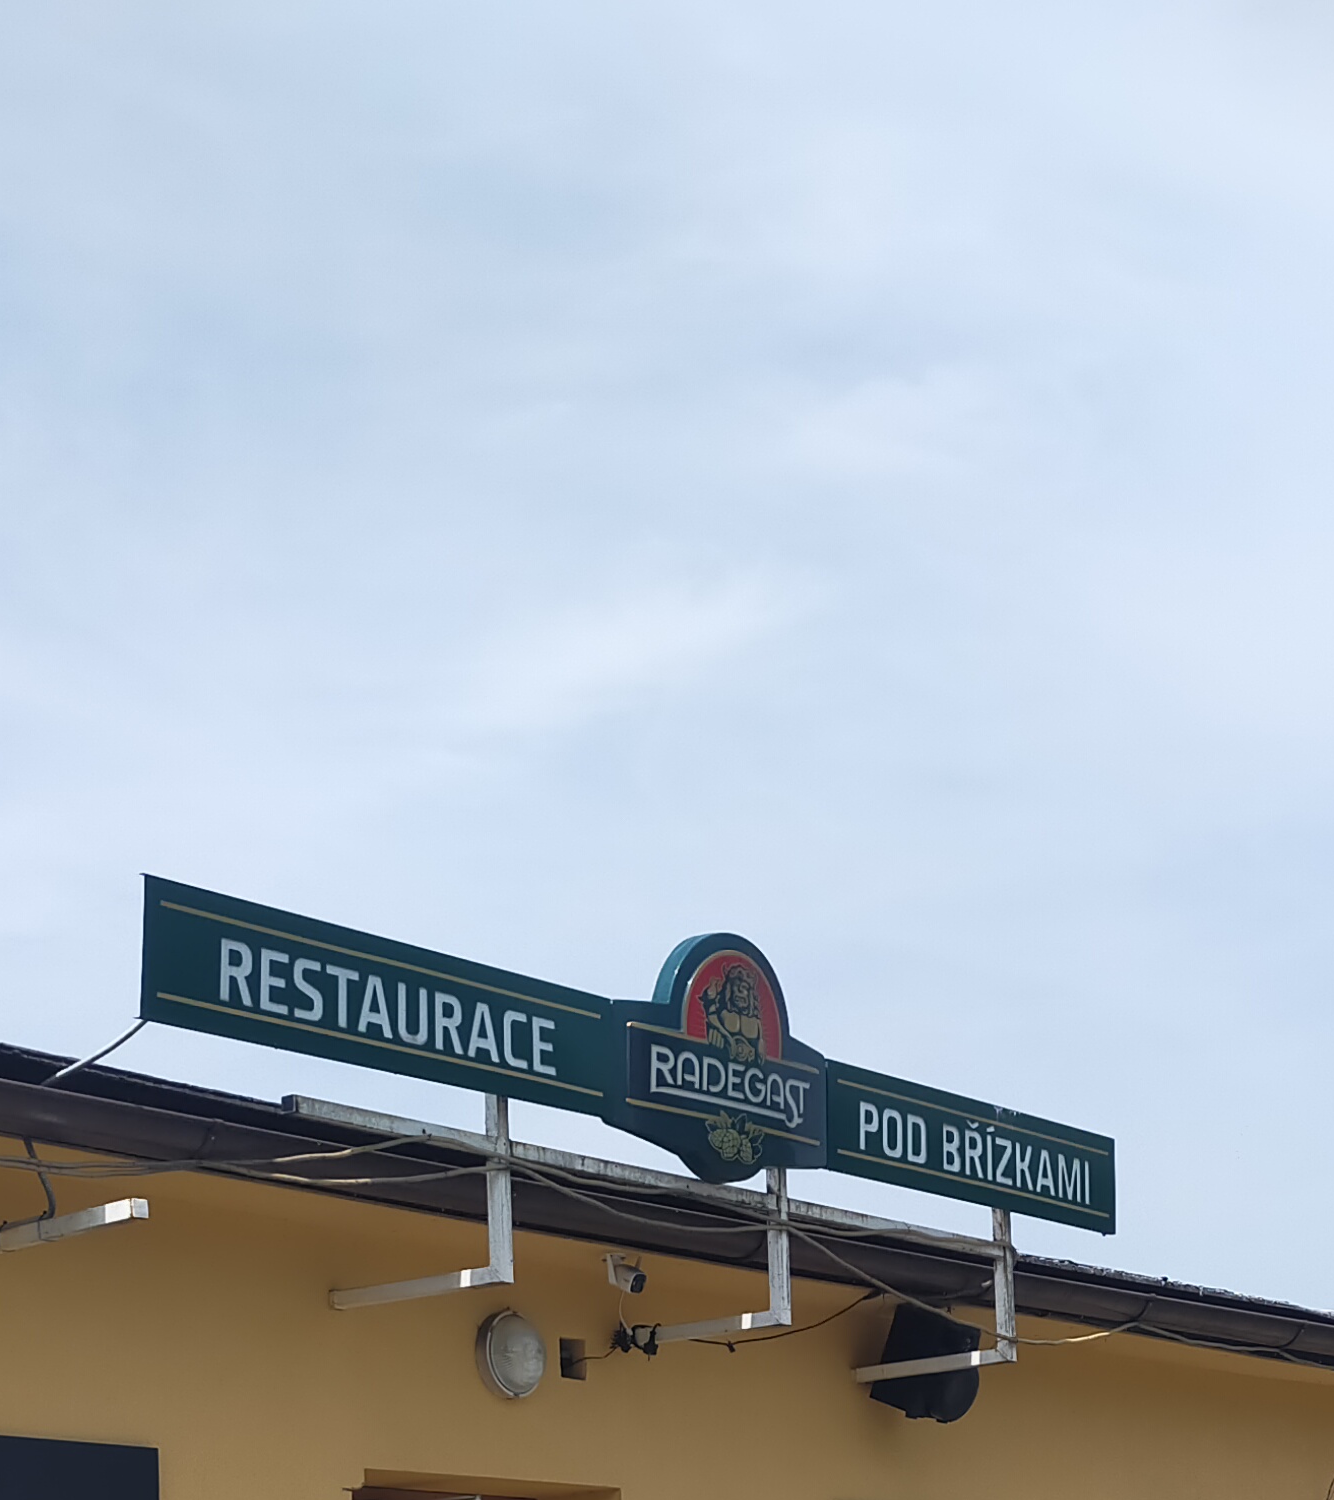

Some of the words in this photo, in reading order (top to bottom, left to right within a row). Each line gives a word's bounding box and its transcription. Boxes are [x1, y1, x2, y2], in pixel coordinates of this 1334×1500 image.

[219, 937, 558, 1078] RESTAURACE
[650, 1043, 811, 1129] RADEGAST
[858, 1101, 929, 1165] POD
[940, 1120, 1092, 1207] BŘÍZKAMI
